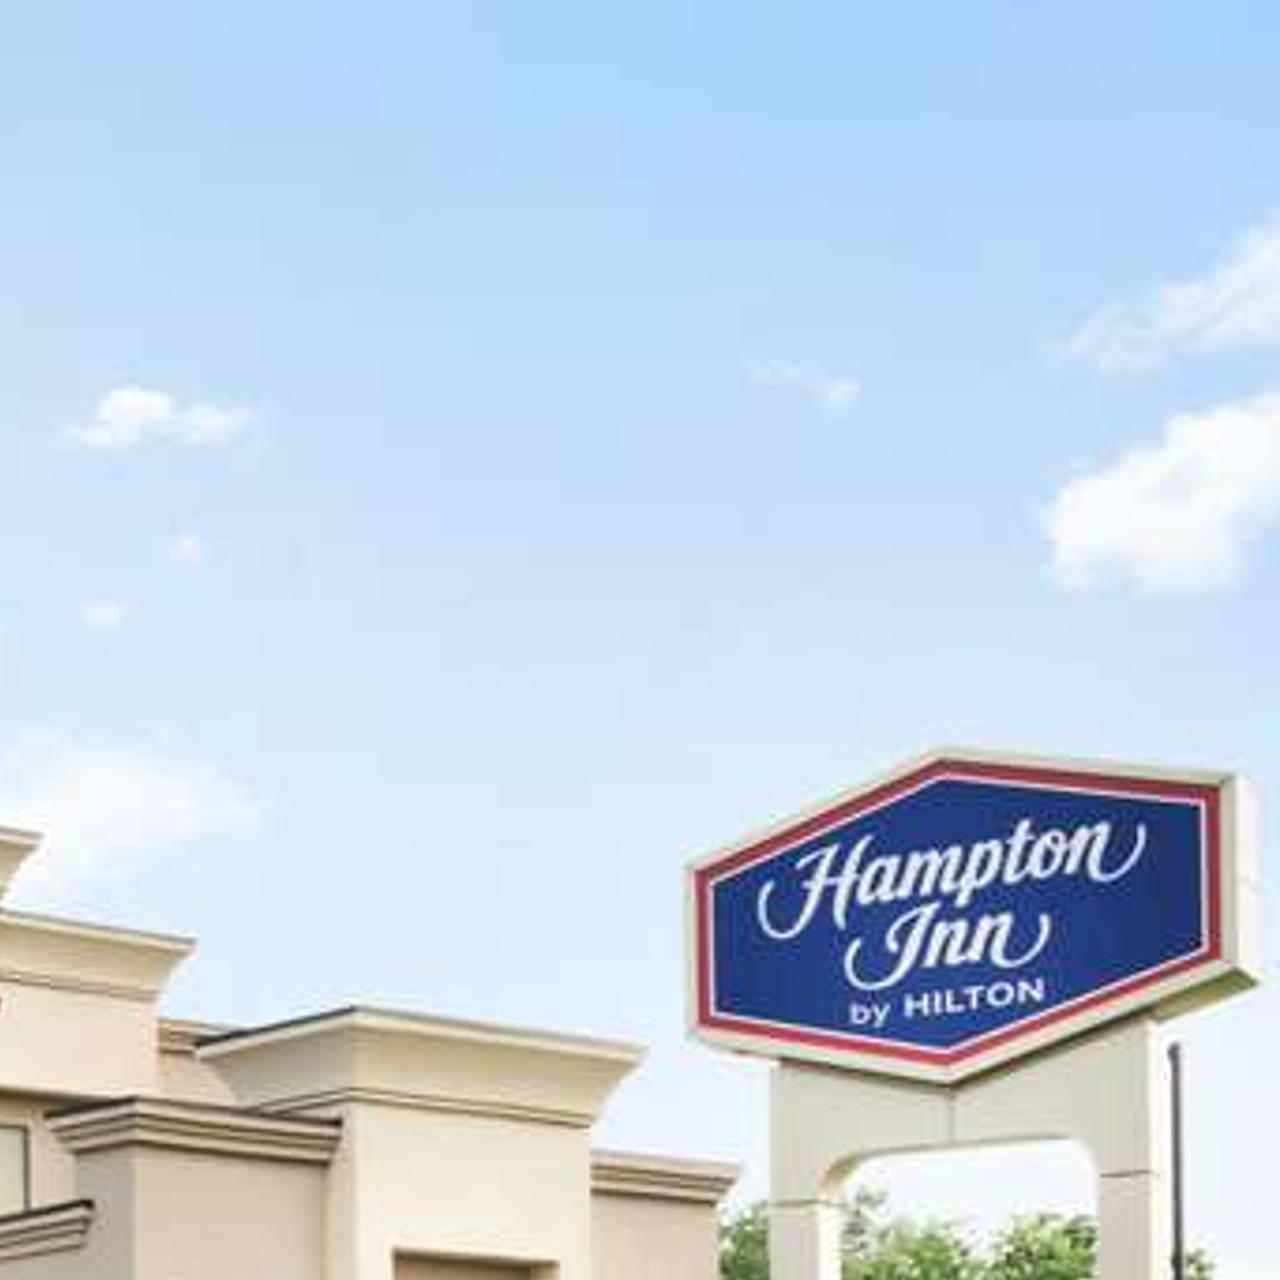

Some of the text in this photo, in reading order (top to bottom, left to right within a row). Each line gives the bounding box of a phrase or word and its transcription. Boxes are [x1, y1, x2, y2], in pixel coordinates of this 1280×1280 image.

[758, 819, 1145, 939] Hampton
[844, 902, 1049, 990] Inn
[851, 980, 1044, 1027] by HILTON
